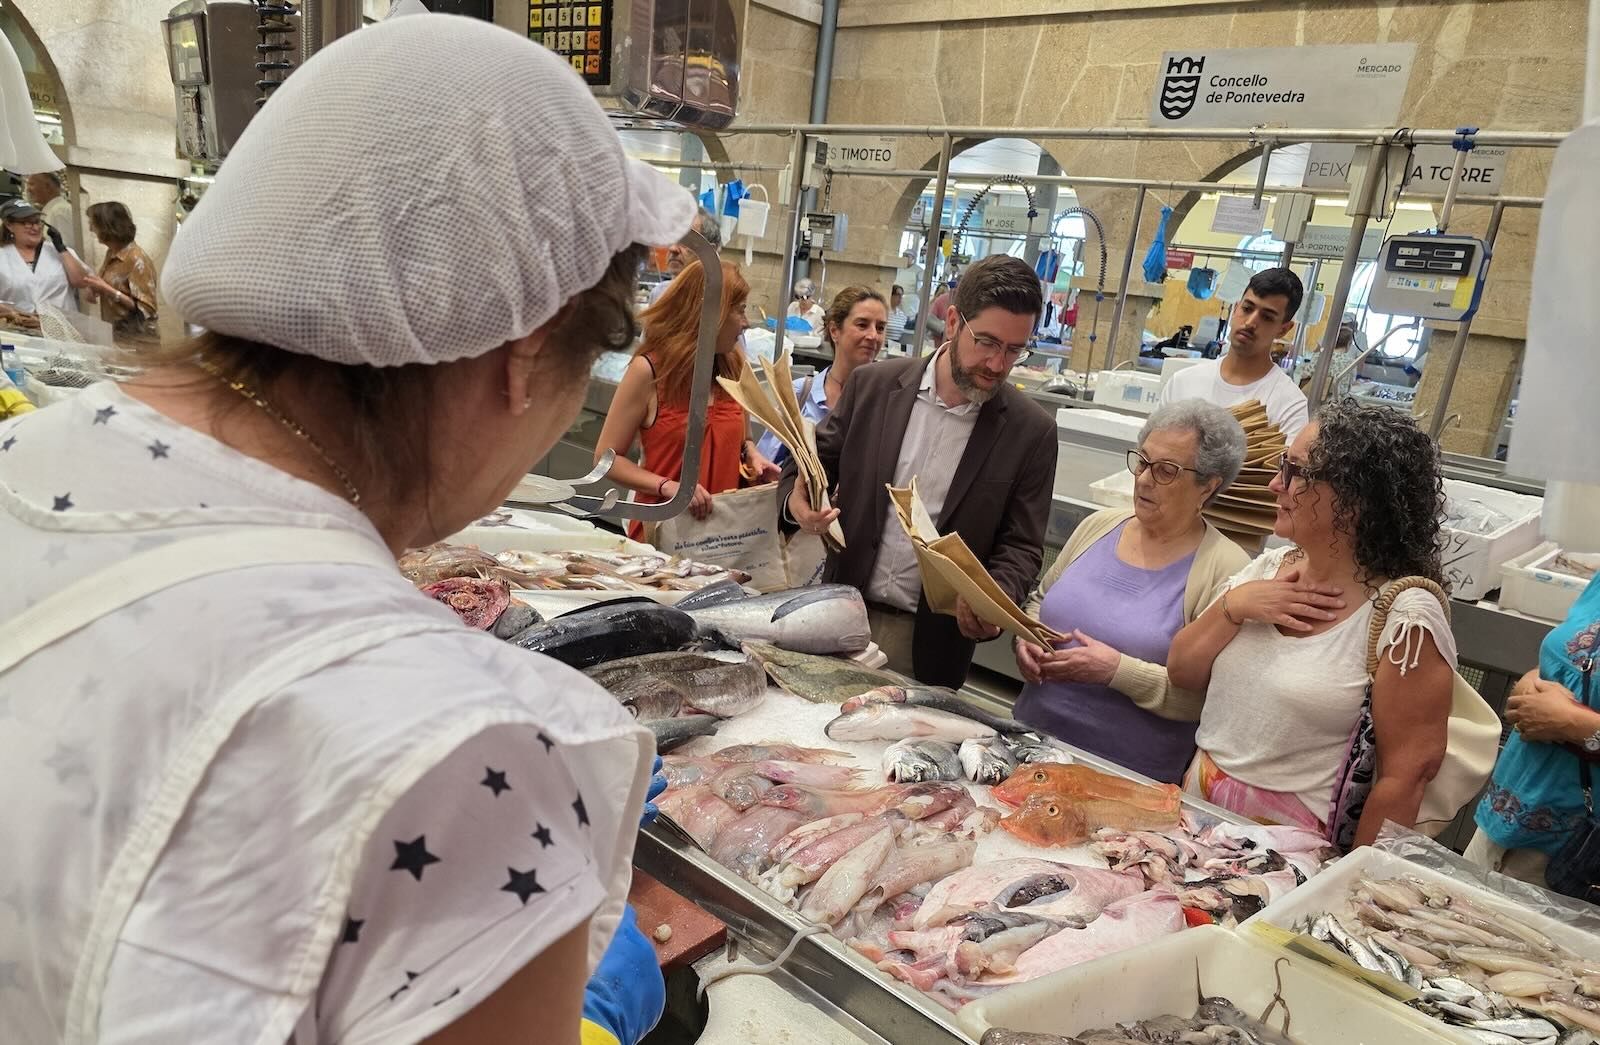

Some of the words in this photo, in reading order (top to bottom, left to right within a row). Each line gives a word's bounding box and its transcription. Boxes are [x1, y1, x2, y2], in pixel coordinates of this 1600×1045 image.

[547, 13, 552, 21] 4
[561, 12, 567, 21] 5
[576, 11, 582, 21] 6
[561, 36, 566, 45] 2
[576, 35, 581, 44] 3
[1210, 75, 1267, 87] Concello
[1206, 91, 1223, 103] de
[1225, 90, 1305, 103] Pontevedra
[841, 148, 891, 161] TIMOTEO
